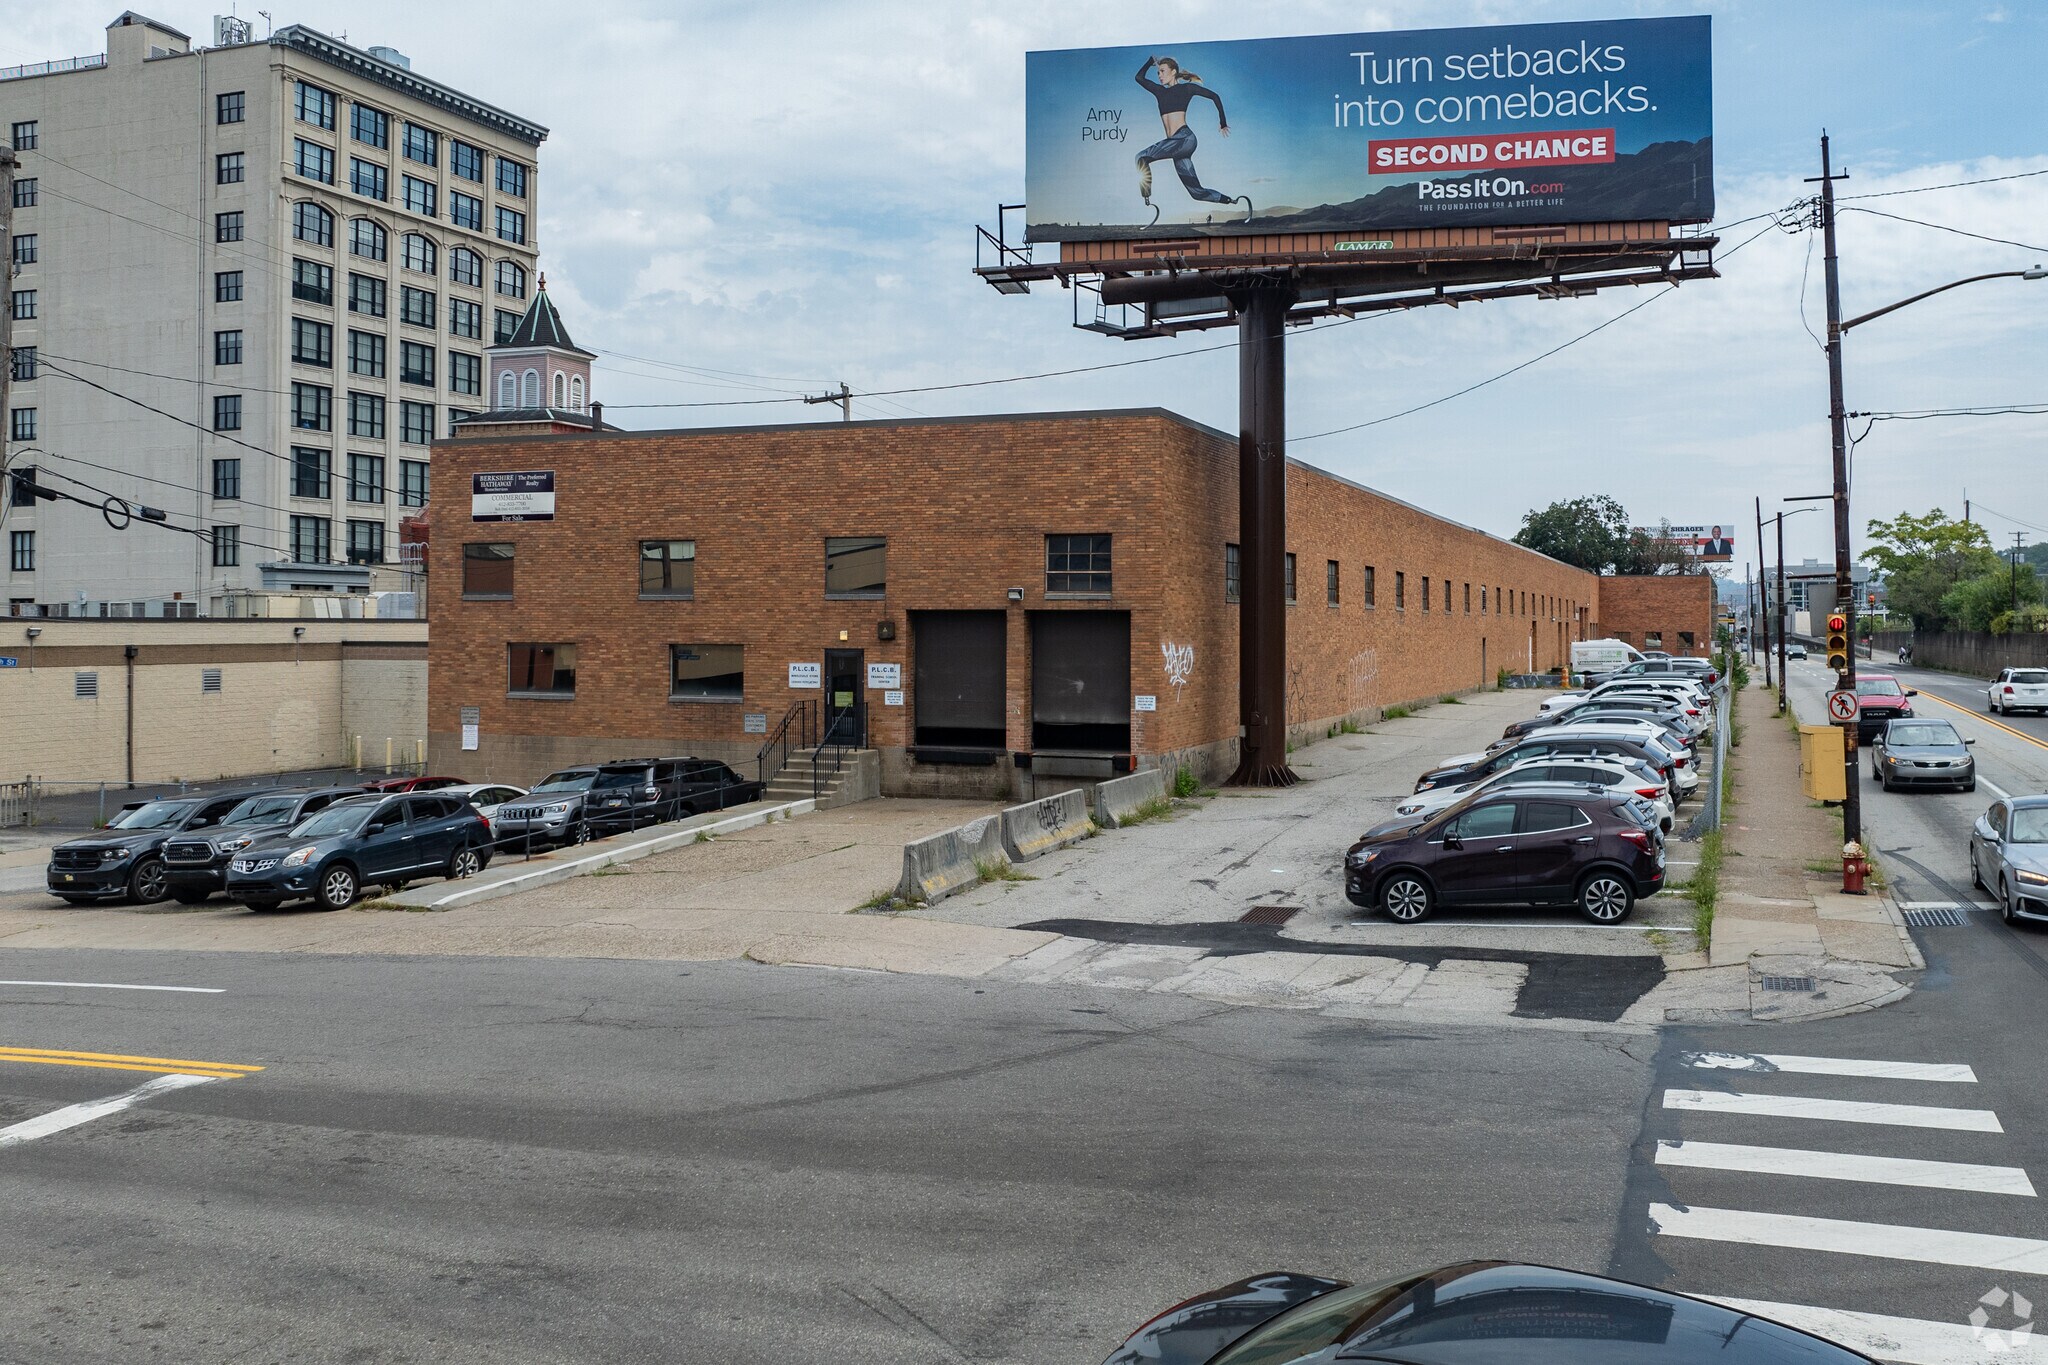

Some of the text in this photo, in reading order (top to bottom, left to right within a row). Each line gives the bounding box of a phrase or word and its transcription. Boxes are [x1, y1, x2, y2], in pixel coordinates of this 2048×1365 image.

[1350, 40, 1626, 85] Turn setbacks
[1334, 80, 1658, 127] into comebacks.
[1086, 107, 1122, 124] Amy
[1082, 126, 1128, 143] Purdy
[1376, 136, 1607, 167] SECOND CHANCE
[1419, 204, 1433, 212] THE
[1437, 202, 1489, 211] FOUNDATION
[1492, 201, 1505, 209] FOR
[1516, 199, 1544, 208] BETTER
[1547, 198, 1563, 206] LIFE
[1339, 242, 1388, 251] LAMAR
